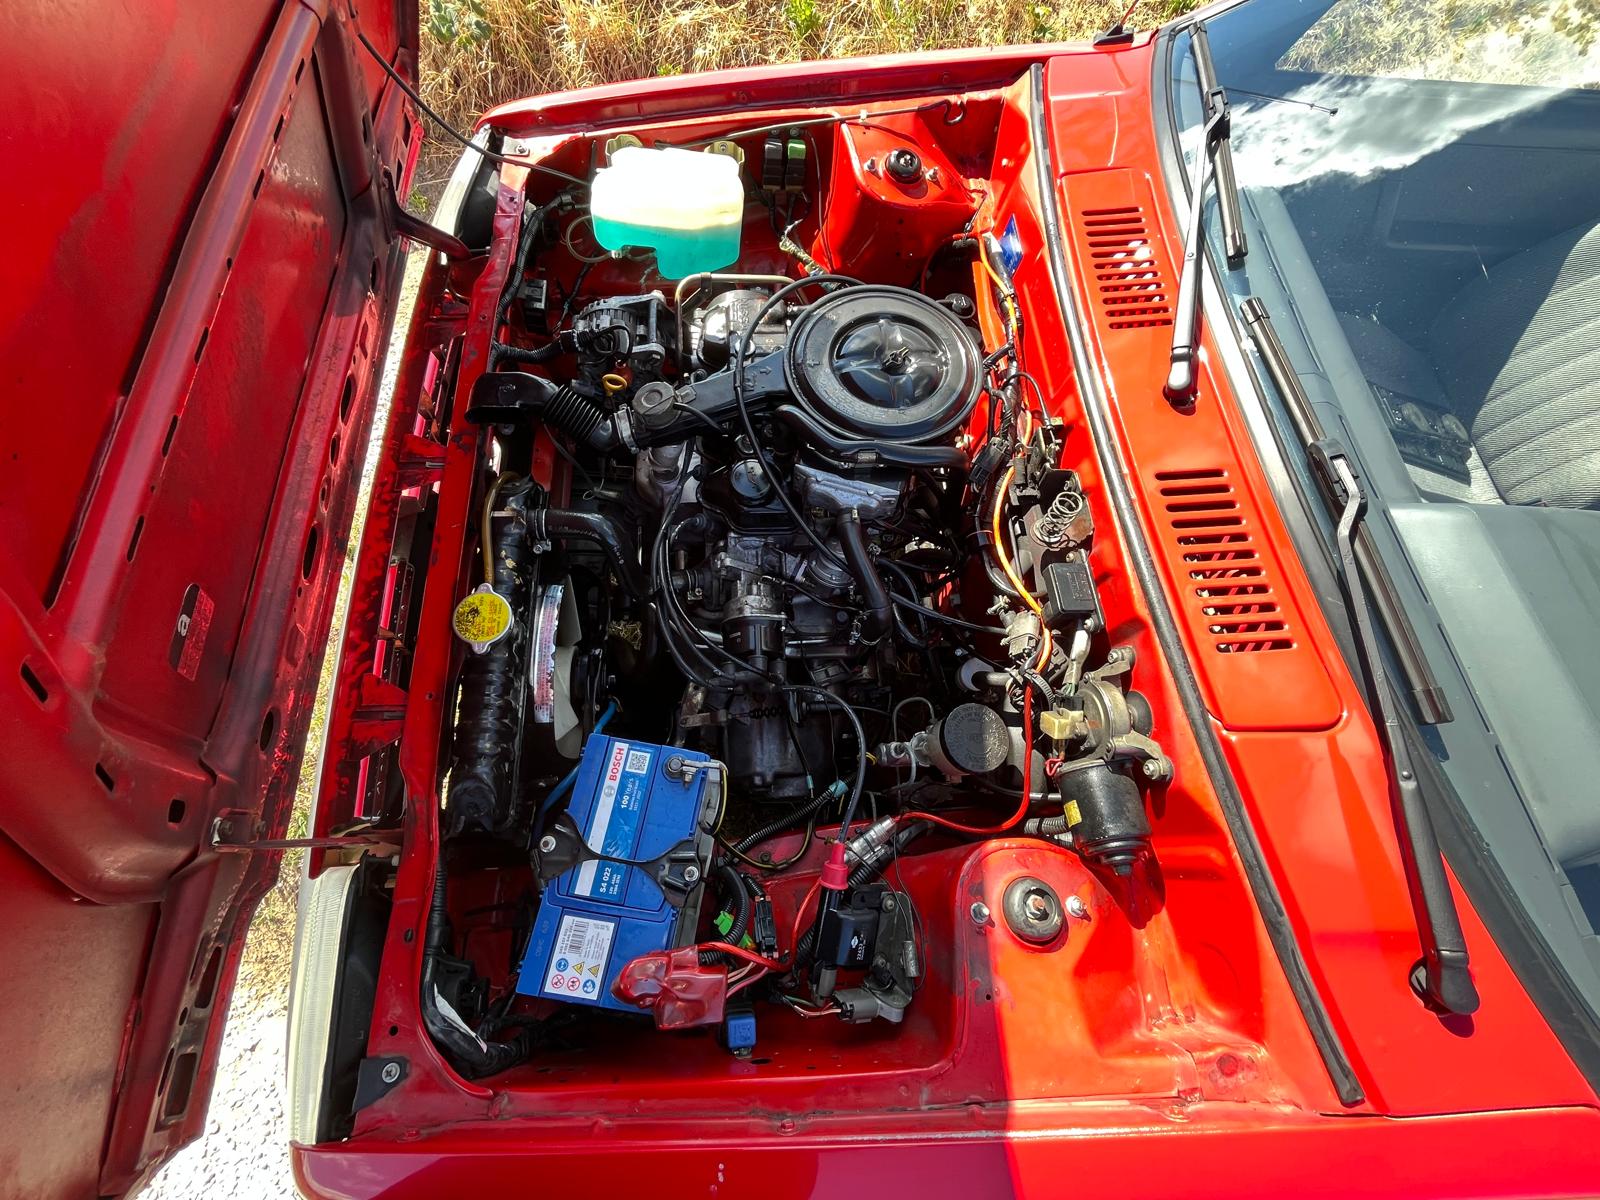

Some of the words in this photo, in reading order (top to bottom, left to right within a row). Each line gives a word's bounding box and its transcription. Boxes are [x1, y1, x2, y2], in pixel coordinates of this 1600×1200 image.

[608, 747, 625, 782] BOSCH
[624, 778, 635, 795] Years
[620, 795, 630, 809] 100
[602, 867, 612, 881] 022
[600, 882, 608, 893] S4
